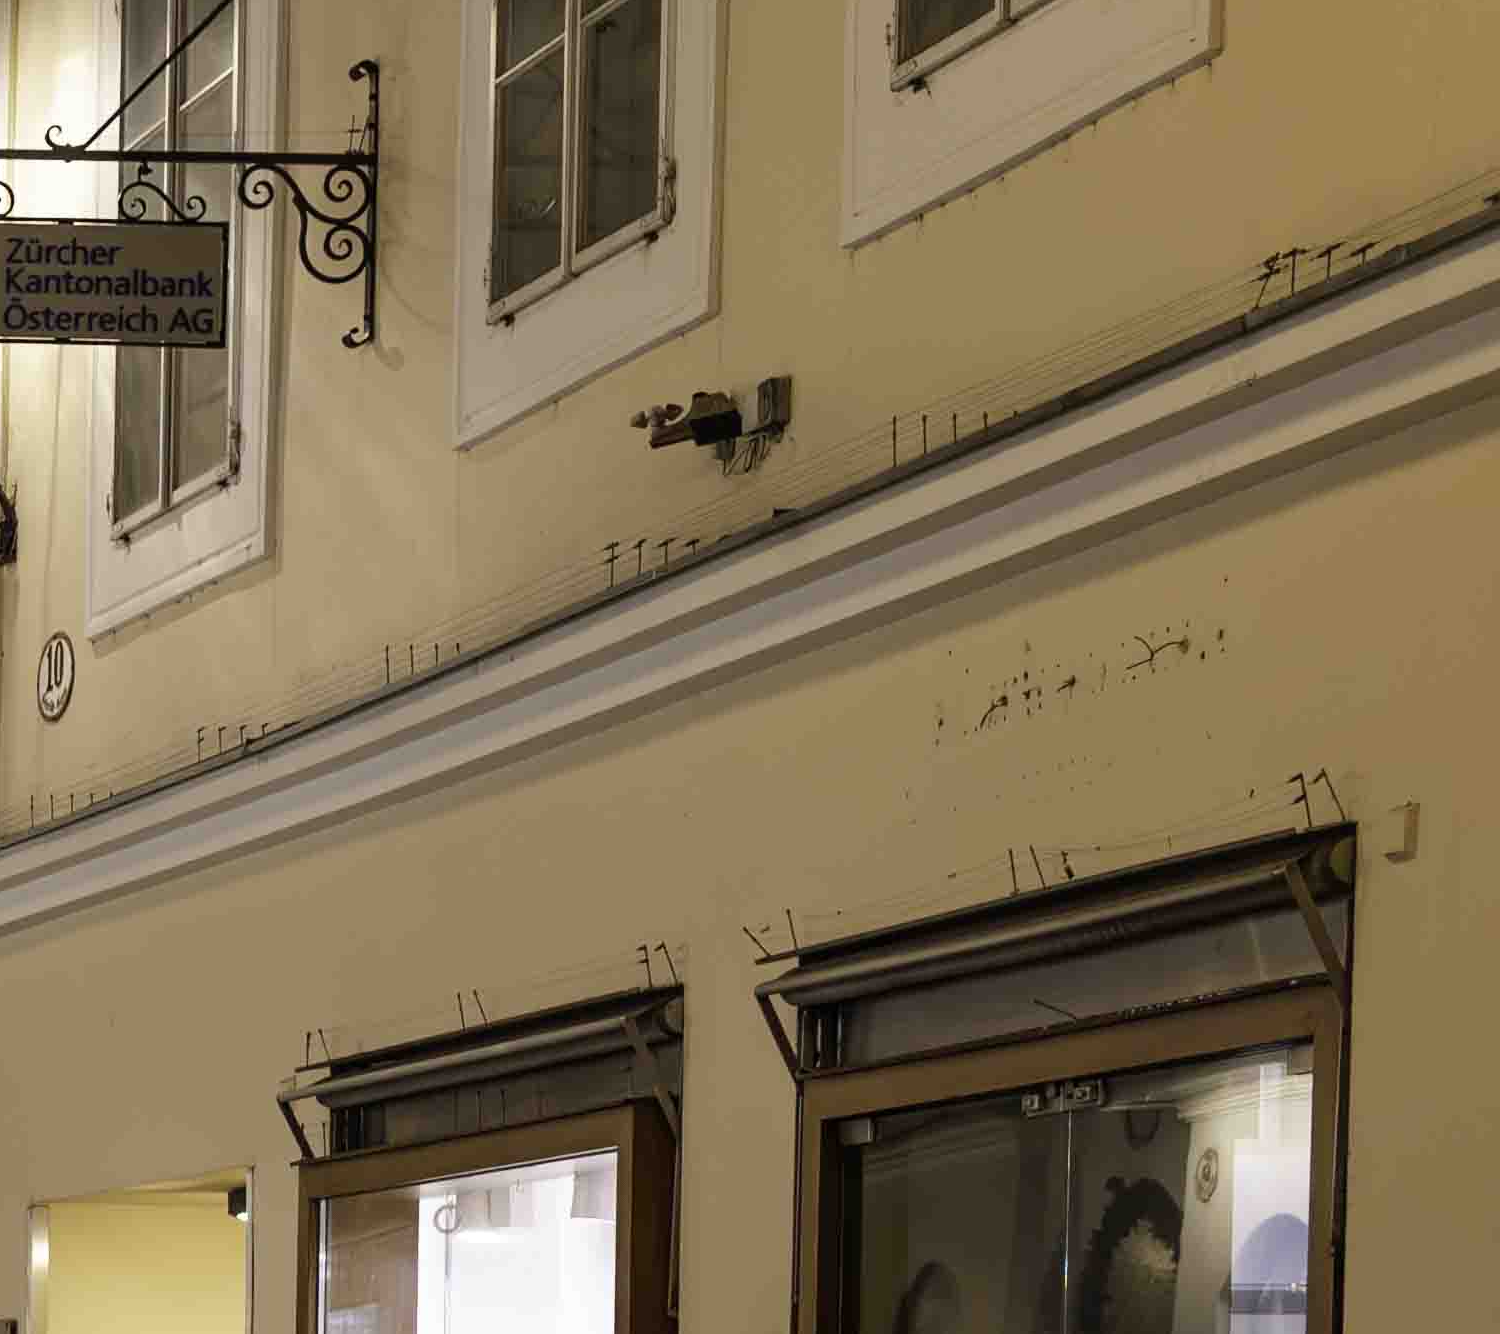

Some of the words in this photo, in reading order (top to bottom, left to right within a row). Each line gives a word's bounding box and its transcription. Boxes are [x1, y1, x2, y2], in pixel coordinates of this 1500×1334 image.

[5, 237, 124, 267] Zürcher
[5, 267, 213, 298] Kantonalbank
[3, 299, 159, 333] Österreich
[168, 309, 213, 334] AG
